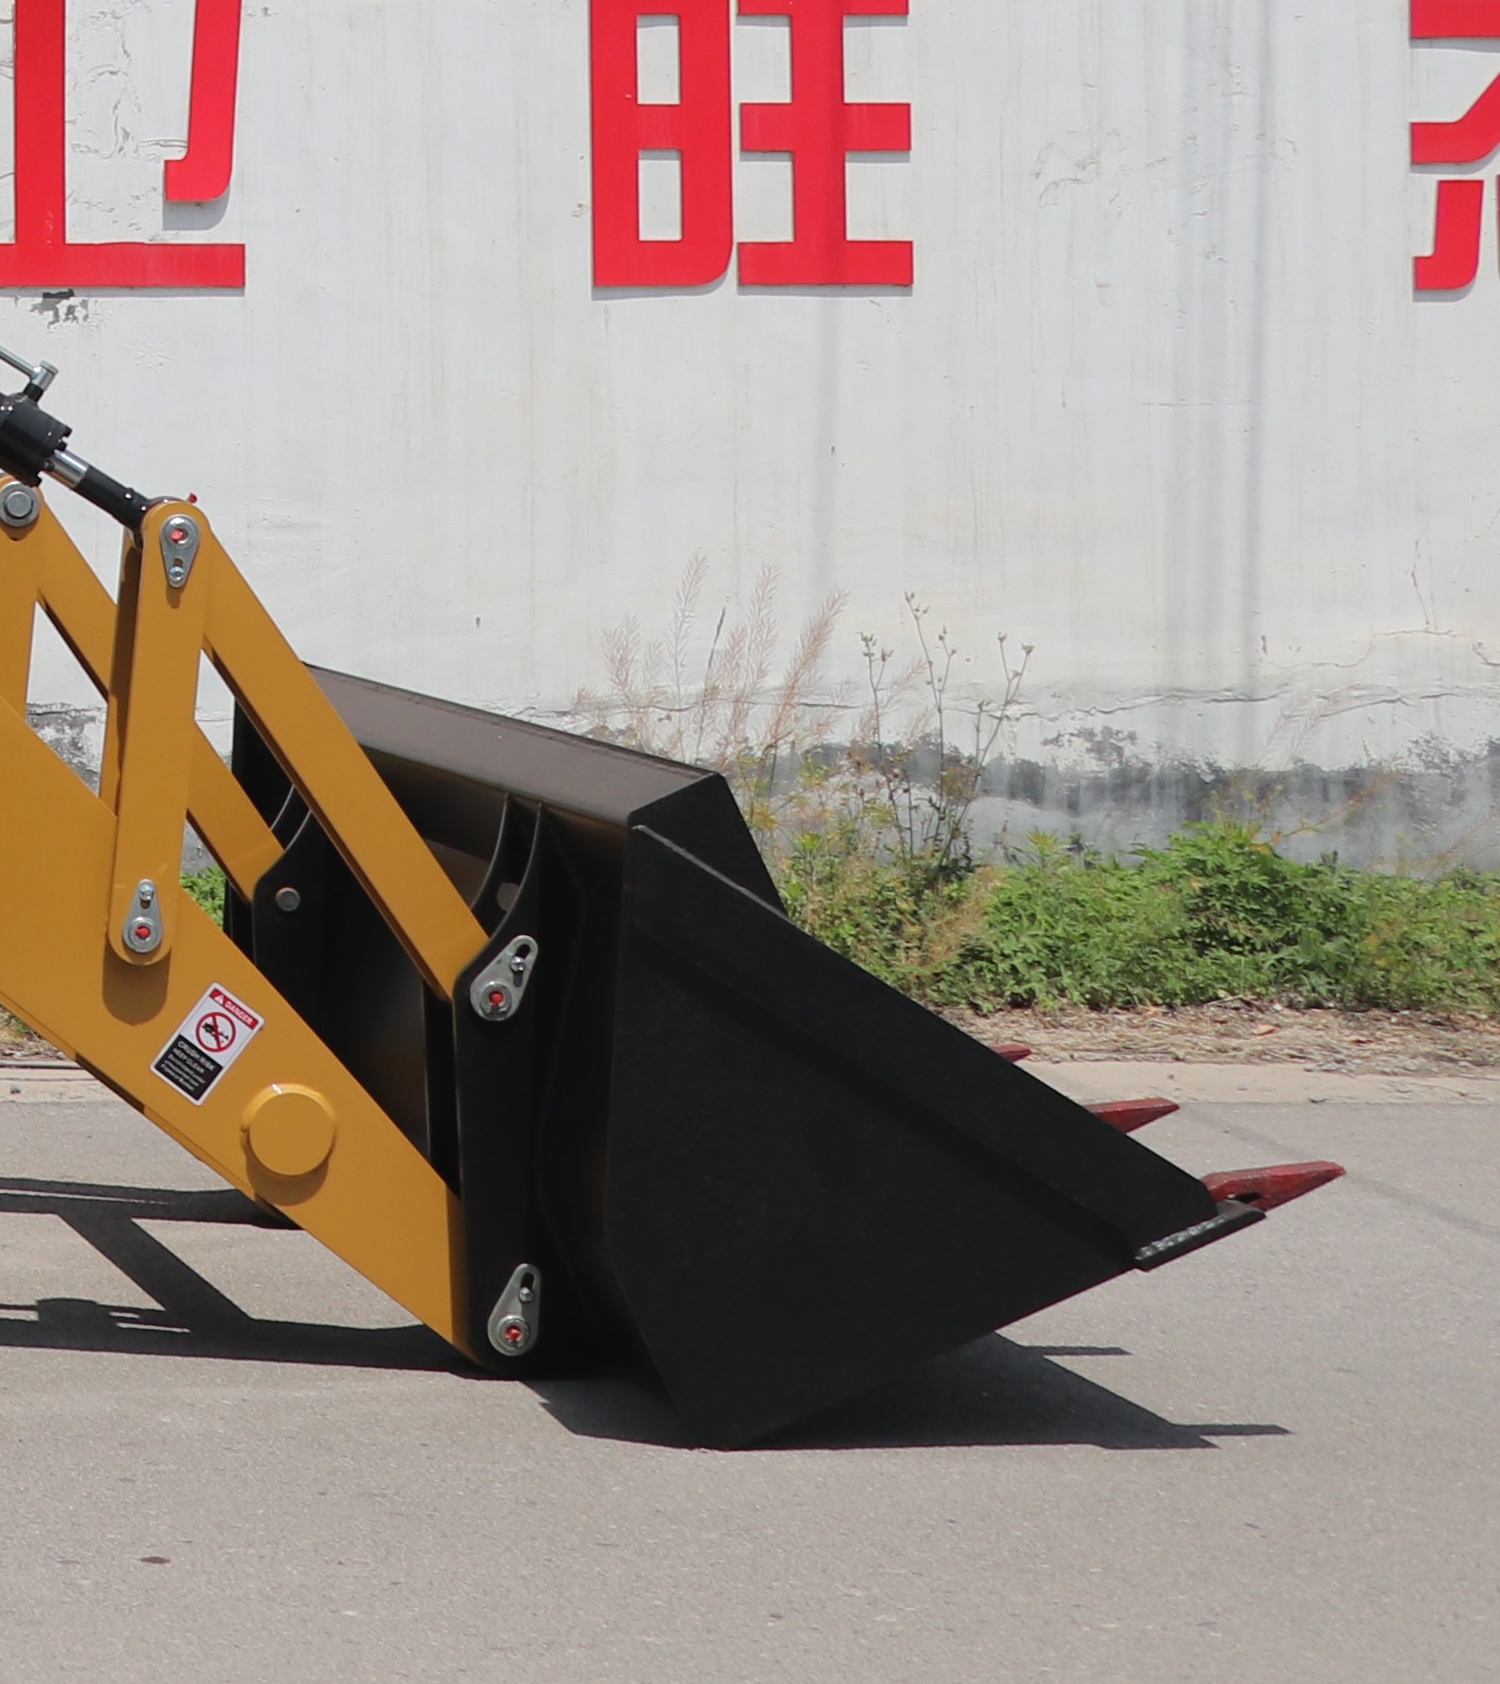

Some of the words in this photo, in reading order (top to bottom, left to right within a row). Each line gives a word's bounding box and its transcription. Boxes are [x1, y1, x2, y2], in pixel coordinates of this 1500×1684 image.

[224, 1000, 254, 1025] DANGER
[177, 1040, 200, 1060] CRUSH
[199, 1055, 216, 1071] RISK
